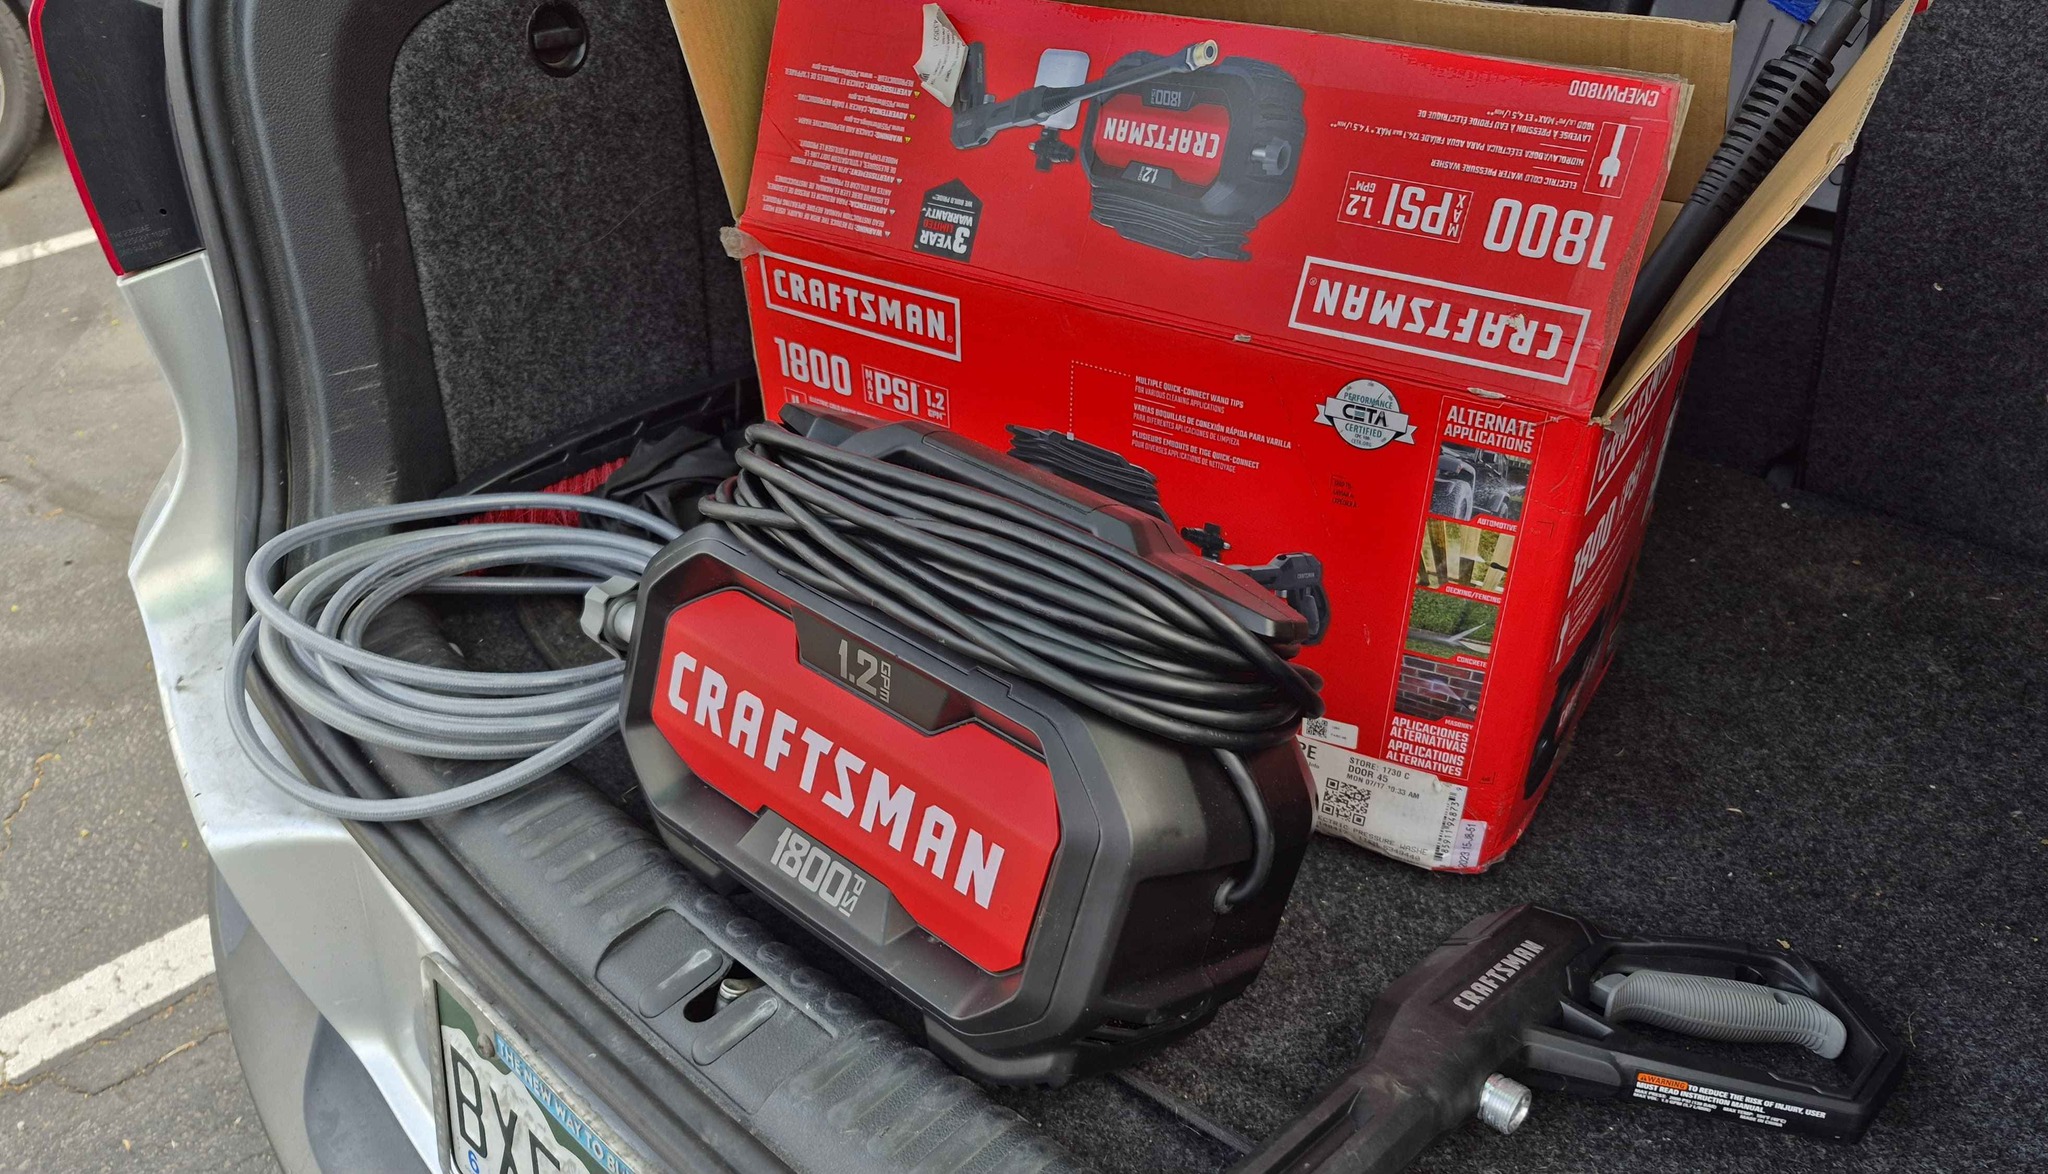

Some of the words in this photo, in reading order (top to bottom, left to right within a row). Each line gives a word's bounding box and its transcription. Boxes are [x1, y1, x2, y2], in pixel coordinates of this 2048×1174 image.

[1155, 89, 1181, 107] 1800
[1567, 79, 1660, 108] CMEPW1800
[1417, 109, 1426, 118] DE
[1426, 110, 1467, 125] ÉLECTRIQUE
[1468, 117, 1494, 128] FROIDE
[1511, 110, 1524, 120] 4,5
[1524, 112, 1534, 121] ET
[1352, 122, 1364, 131] 4.5
[1364, 124, 1370, 132] Y
[1402, 130, 1420, 140] 124.1
[1493, 120, 1508, 131] EAU
[1509, 123, 1515, 132] À
[1515, 124, 1551, 137] PRESSION
[1551, 129, 1558, 138] À
[1102, 116, 1221, 159] CRAFTSMAN
[1445, 136, 1465, 147] AGUA
[1465, 140, 1485, 151] PARA
[1558, 130, 1591, 143] LAVEUSE
[1486, 143, 1523, 158] ELÉCTRICA
[1524, 149, 1584, 166] HIDROLAVADORA
[1430, 158, 1460, 170] WASHER
[1461, 163, 1497, 177] PRESSURE
[1497, 169, 1523, 181] WATER
[1523, 173, 1543, 184] COLD
[1543, 176, 1577, 190] ELECTRIC
[964, 199, 973, 207] WE
[1344, 192, 1374, 219] 1.2
[924, 206, 973, 226] WARRANTY
[1447, 193, 1467, 238] MAX
[921, 218, 953, 233] LIMITED
[1481, 195, 1614, 270] 1800
[919, 229, 955, 250] YEAR
[954, 225, 971, 253] 3
[774, 336, 853, 397] 1800
[864, 368, 876, 402] MAX
[1134, 375, 1163, 388] MULTIPLE
[1162, 382, 1209, 400] QUICK-CONNECT
[1209, 393, 1229, 405] WAND
[1229, 398, 1244, 408] TIPS
[922, 388, 947, 411] 1.2
[1343, 391, 1393, 409] PERFORMANCE
[1341, 402, 1389, 427] CETA
[1446, 404, 1537, 439] ALTERNATE
[1132, 403, 1154, 415] VARIAS
[1186, 416, 1195, 425] DE
[1224, 425, 1248, 438] RÁPIDA
[1247, 431, 1266, 443] PARA
[1265, 435, 1290, 449] VARILLA
[1344, 422, 1382, 438] CERTIFIED
[1443, 422, 1532, 453] APPLICATIONS
[1189, 444, 1198, 453] DE
[1198, 446, 1212, 457] TIGE
[1211, 450, 1259, 469] QUICK-CONNECT
[1476, 517, 1517, 532] AUTOMOTIVE
[1445, 585, 1501, 603] DECKING/FENCING
[837, 638, 879, 696] 1.2
[1456, 655, 1487, 668] CONCRETE
[1391, 715, 1469, 742] APLICACIONES
[1444, 718, 1474, 730] MASONRY
[1389, 726, 1467, 753] ALTERNATIVAS
[1387, 738, 1464, 766] APPLICATIONS
[1348, 756, 1379, 771] STORE:
[1381, 765, 1402, 777] 1730
[1403, 771, 1410, 780] C
[1385, 750, 1462, 776] ALTERNATIVES
[667, 650, 1005, 909] CRAFTSMAN
[1347, 764, 1374, 778] DOOR
[1376, 773, 1389, 783] 45
[1345, 773, 1363, 783] MON
[1364, 778, 1384, 789] 07/17
[1407, 790, 1420, 799] AM
[1352, 826, 1396, 846] PRESSURE
[1399, 841, 1428, 856] WASHE
[769, 826, 850, 908] 1800
[1452, 934, 1544, 1014] CRAFTSMAN
[497, 1038, 522, 1073] THE
[522, 1070, 552, 1106] NEW
[553, 1099, 583, 1135] WAY
[584, 1130, 604, 1156] TO
[1635, 1081, 1658, 1092] MUST
[1658, 1085, 1679, 1096] READ
[1679, 1090, 1730, 1106] INSTRUCTION
[1727, 1099, 1765, 1113] MANUAL.
[1647, 1075, 1685, 1089] WARNING
[1687, 1083, 1697, 1092] TO
[1698, 1086, 1728, 1098] REDUCE
[1726, 1091, 1744, 1102] THE
[1744, 1095, 1763, 1106] RISK
[1762, 1099, 1774, 1108] OF
[1773, 1101, 1804, 1114] INJURY,
[1804, 1107, 1826, 1119] USER
